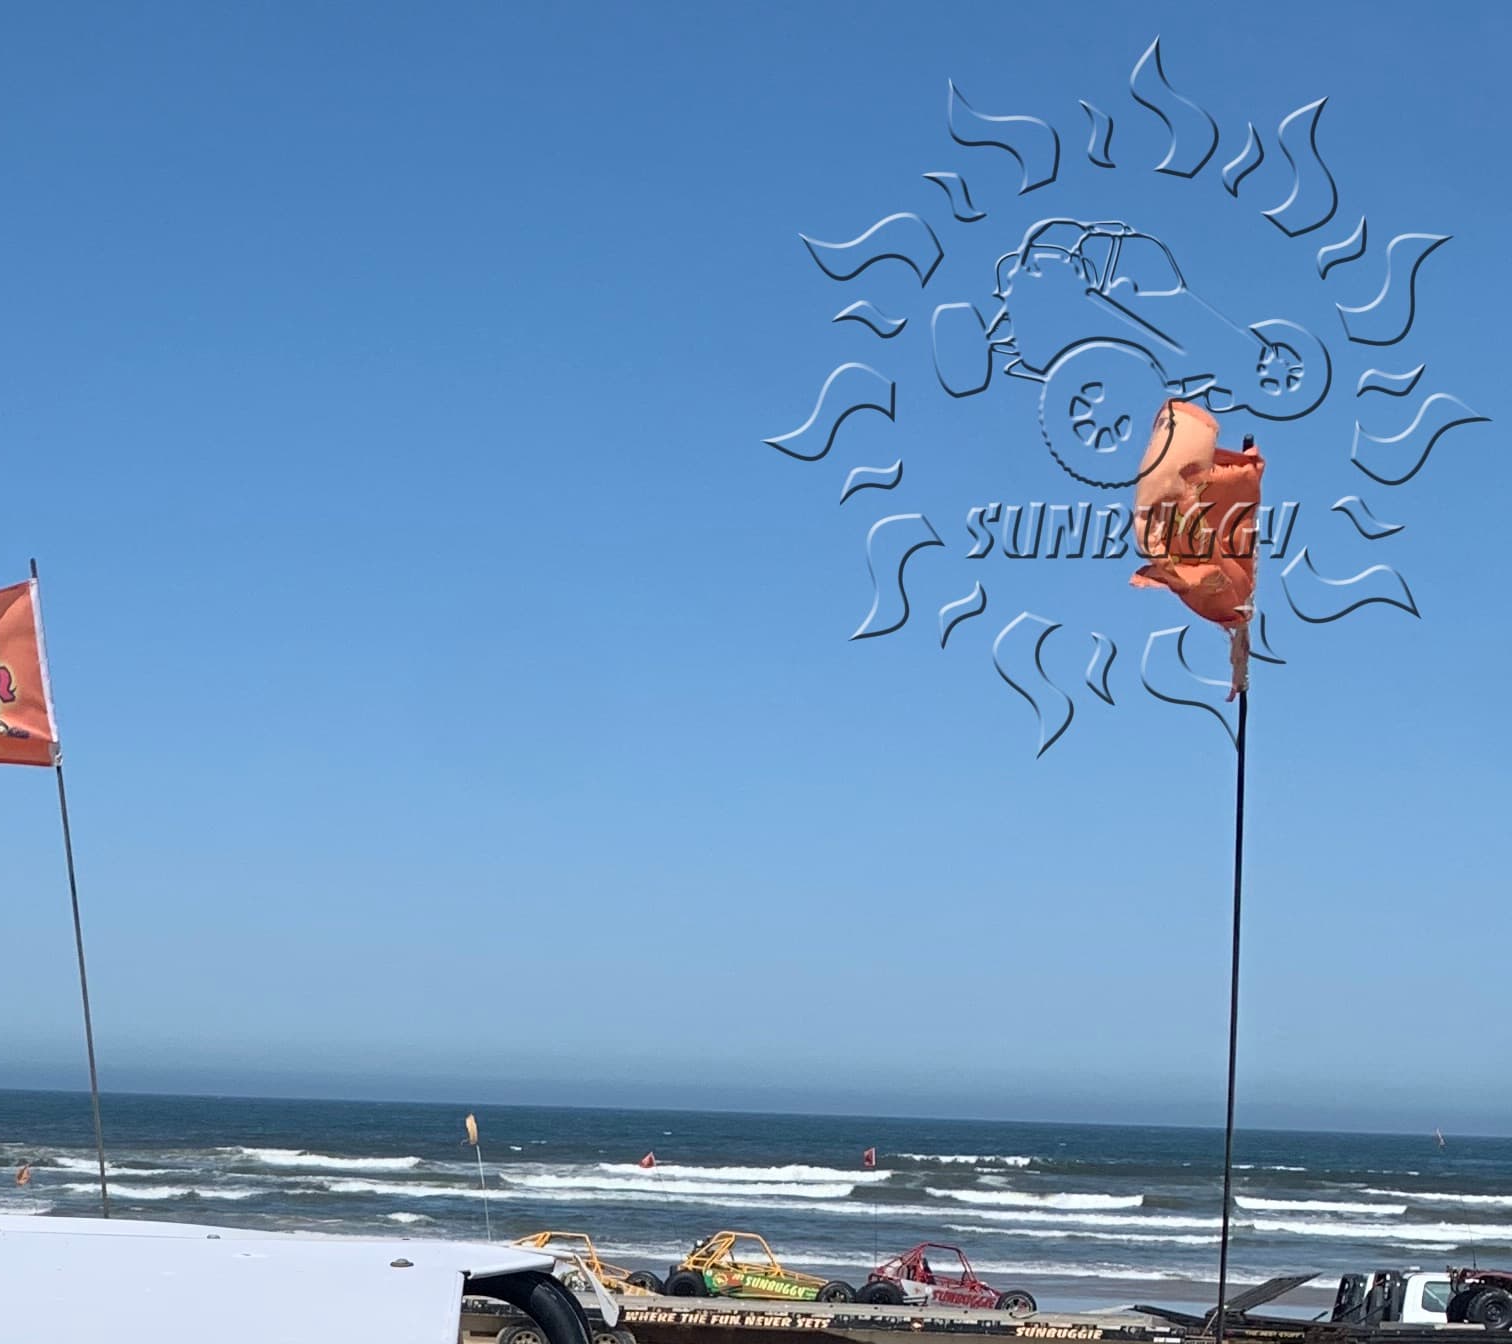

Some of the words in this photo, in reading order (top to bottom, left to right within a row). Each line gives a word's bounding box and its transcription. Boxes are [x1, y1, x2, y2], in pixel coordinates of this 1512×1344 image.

[745, 1275, 805, 1298] SUNBUGGY
[625, 1311, 676, 1323] WHERE
[680, 1313, 706, 1325] THE
[710, 1315, 740, 1326] FUN
[744, 1315, 792, 1328] NEVER
[796, 1317, 832, 1329] SETS
[1015, 1326, 1104, 1340] SUNBUGGIE
